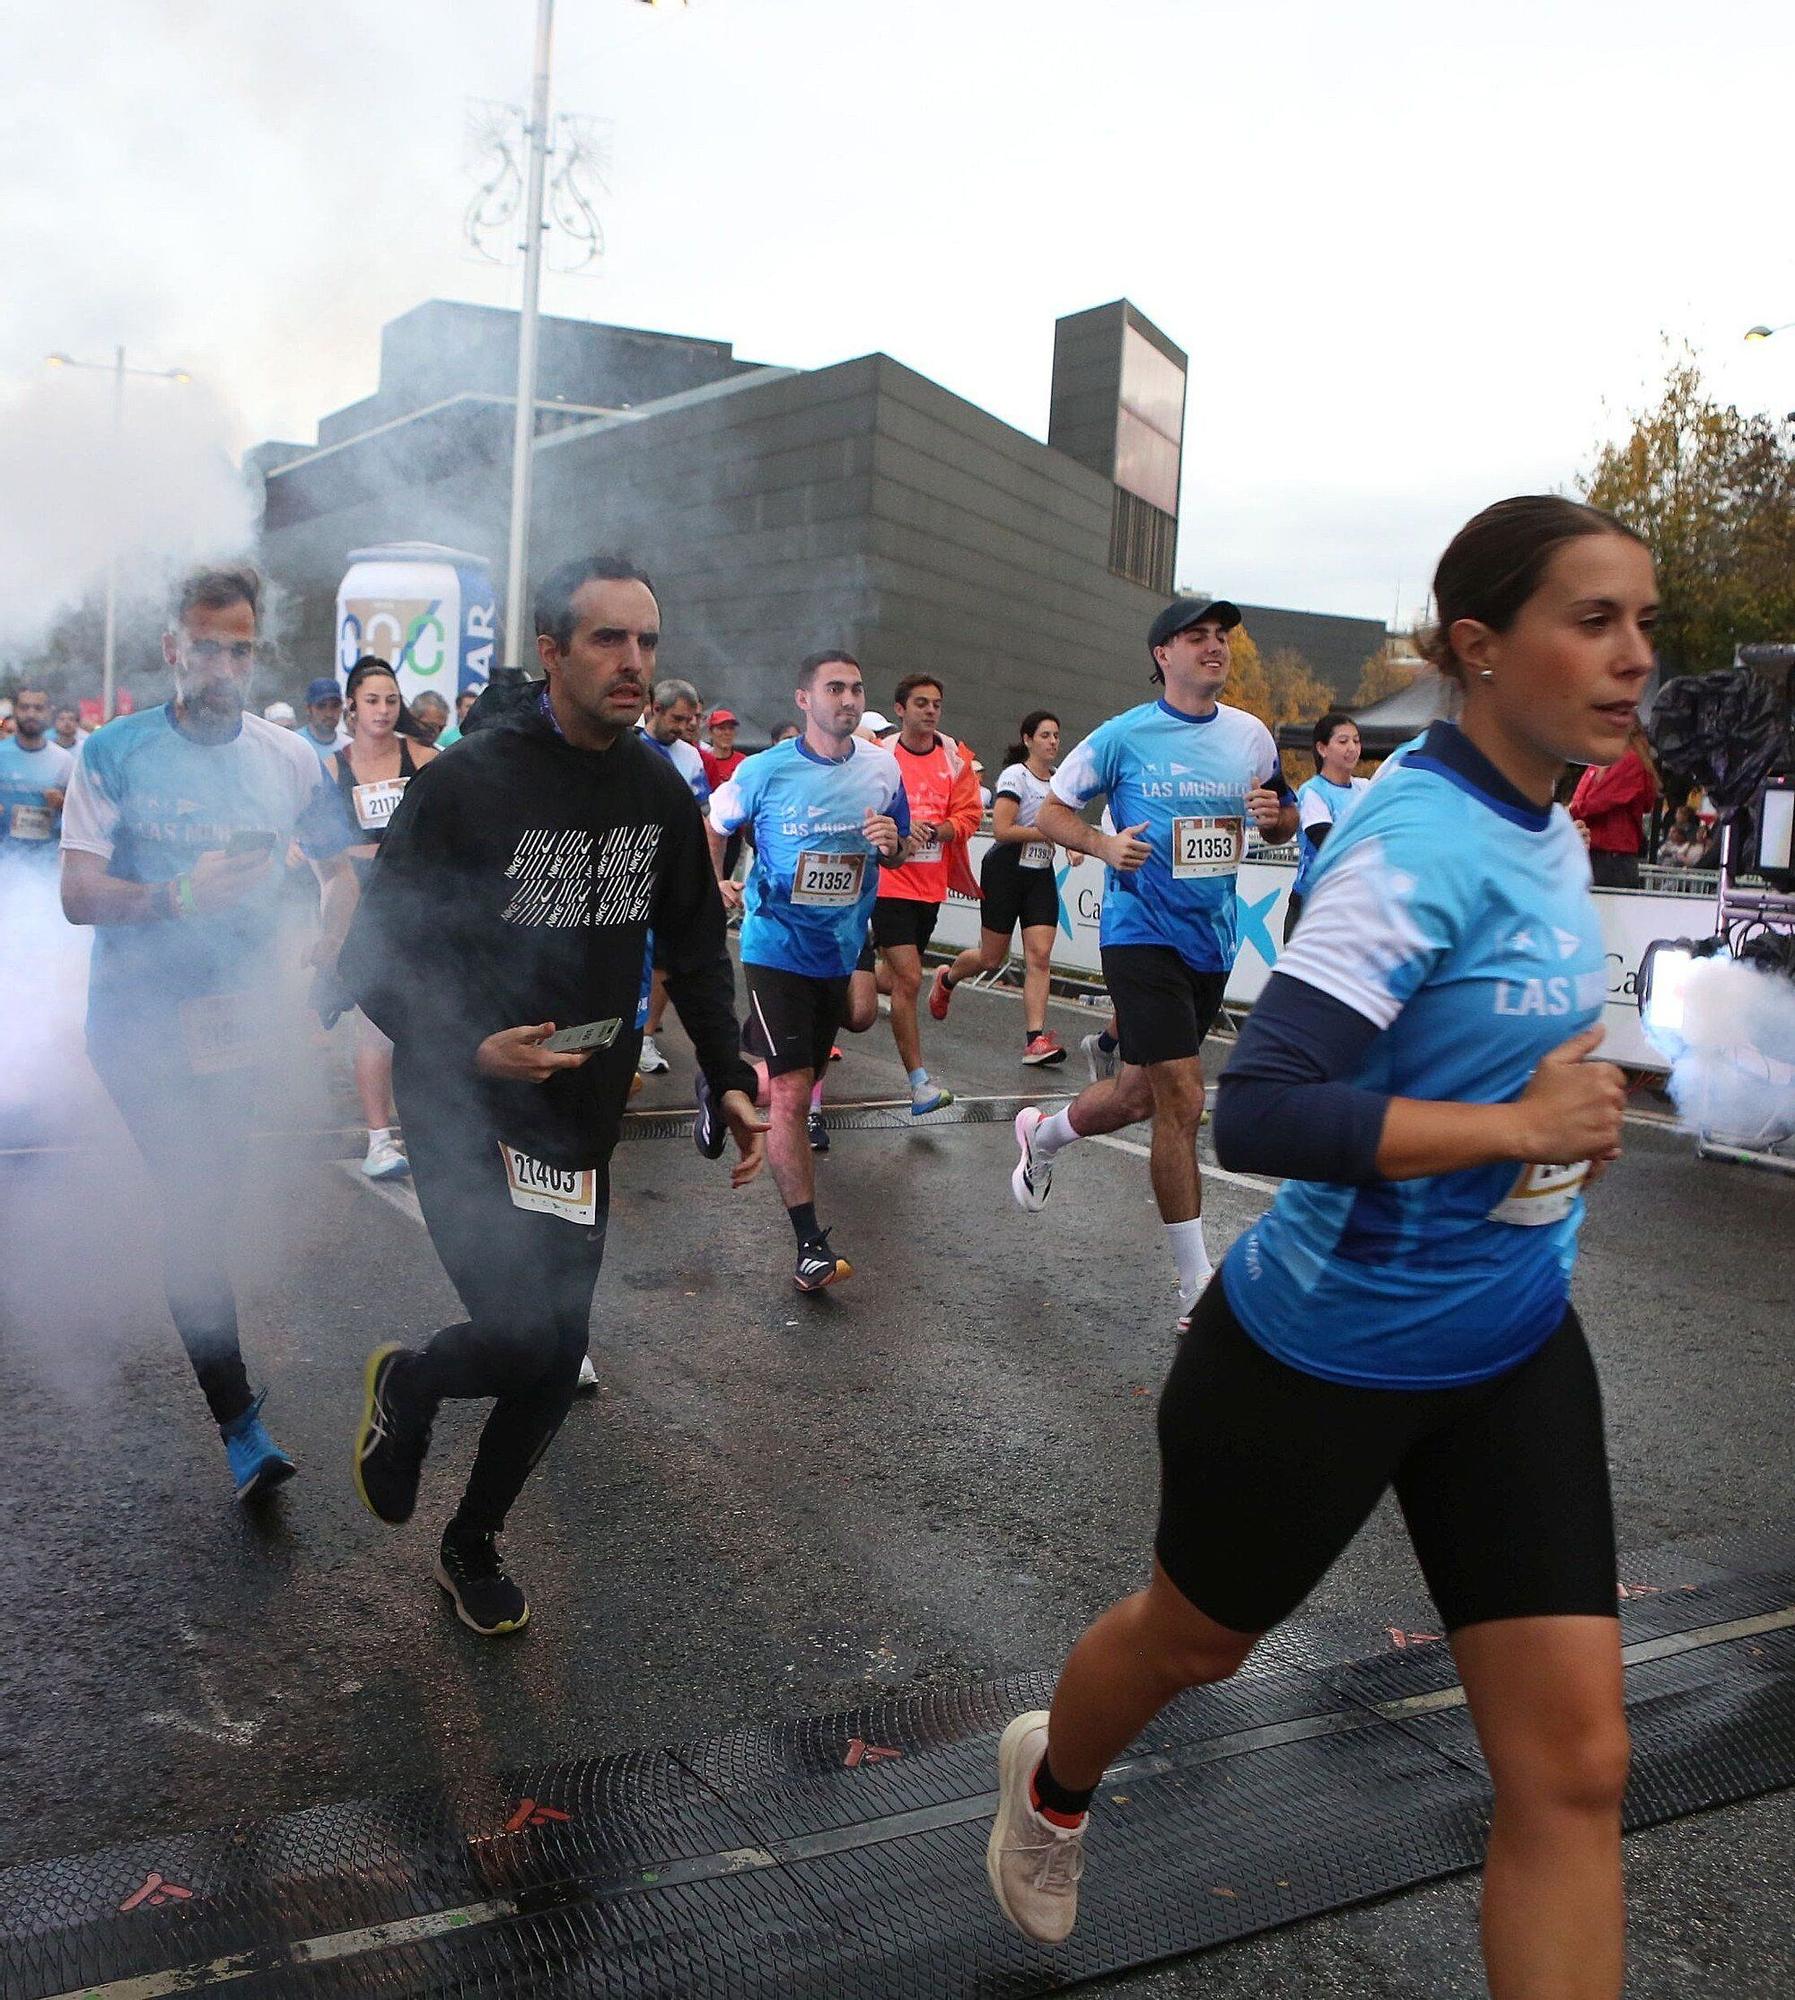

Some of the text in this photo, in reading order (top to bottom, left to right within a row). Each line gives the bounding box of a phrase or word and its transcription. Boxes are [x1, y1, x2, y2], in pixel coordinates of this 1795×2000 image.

[1142, 782, 1173, 798] LAS
[369, 796, 401, 815] 2117
[782, 822, 809, 837] LAS
[1187, 837, 1232, 859] 21353
[504, 854, 525, 879] NIKE
[548, 854, 564, 879] NIKE
[628, 850, 644, 873] NIKE
[806, 871, 852, 890] 21352
[501, 901, 521, 921] NIKE
[545, 904, 564, 927] NIKE
[628, 897, 644, 921] NIKE
[1495, 977, 1570, 1015] LAS
[514, 1154, 576, 1193] 21403
